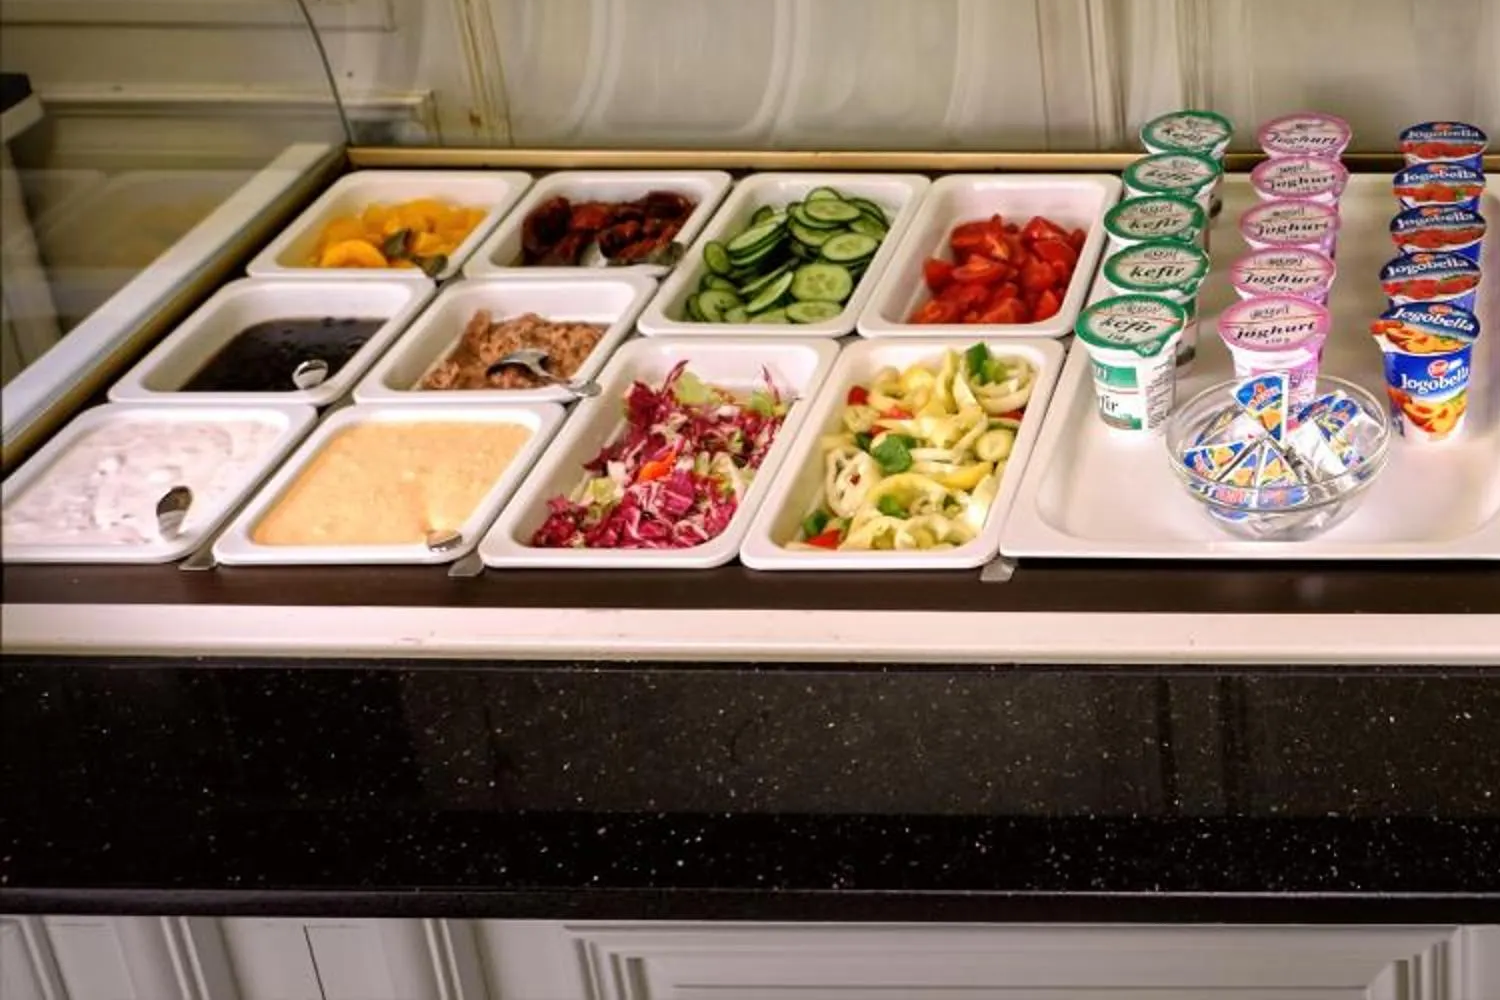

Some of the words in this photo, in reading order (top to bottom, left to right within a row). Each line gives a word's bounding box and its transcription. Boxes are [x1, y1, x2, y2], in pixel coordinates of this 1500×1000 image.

[1129, 218, 1180, 231] kefir
[1129, 265, 1184, 279] kefir
[1391, 308, 1475, 331] Jogobella
[1401, 366, 1470, 393] Jogobell
